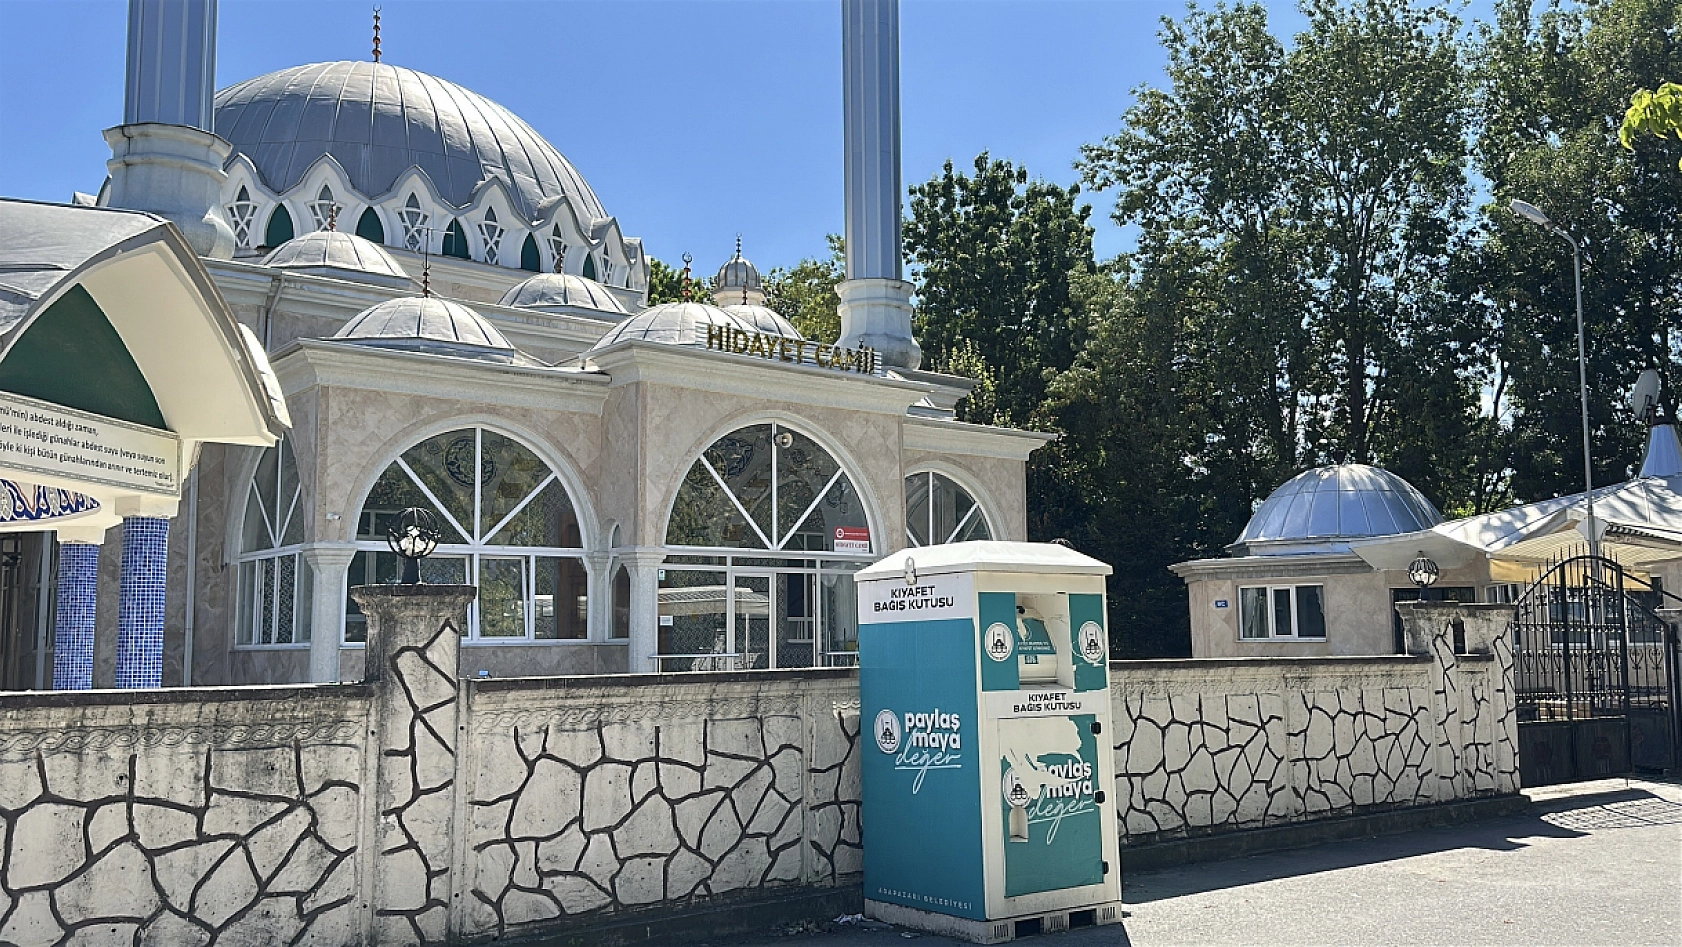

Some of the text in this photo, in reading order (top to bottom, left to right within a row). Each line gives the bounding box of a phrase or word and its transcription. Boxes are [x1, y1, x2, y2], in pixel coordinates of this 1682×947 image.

[706, 322, 807, 364] HİDAYET
[30, 412, 54, 426] abdest
[16, 442, 22, 453] ki
[24, 444, 35, 457] kişi
[37, 446, 57, 460] bütün
[50, 434, 80, 447] günahlar
[81, 440, 103, 452] abdest
[890, 585, 936, 599] KIYAFET
[908, 596, 954, 610] KUTUSU
[1028, 692, 1067, 702] KIYAFET
[1044, 701, 1082, 712] KUTUSU
[904, 707, 961, 734] paylaş
[912, 731, 961, 753] maya
[895, 728, 962, 795] değer
[1046, 779, 1093, 799] maya
[1028, 785, 1094, 846] değer
